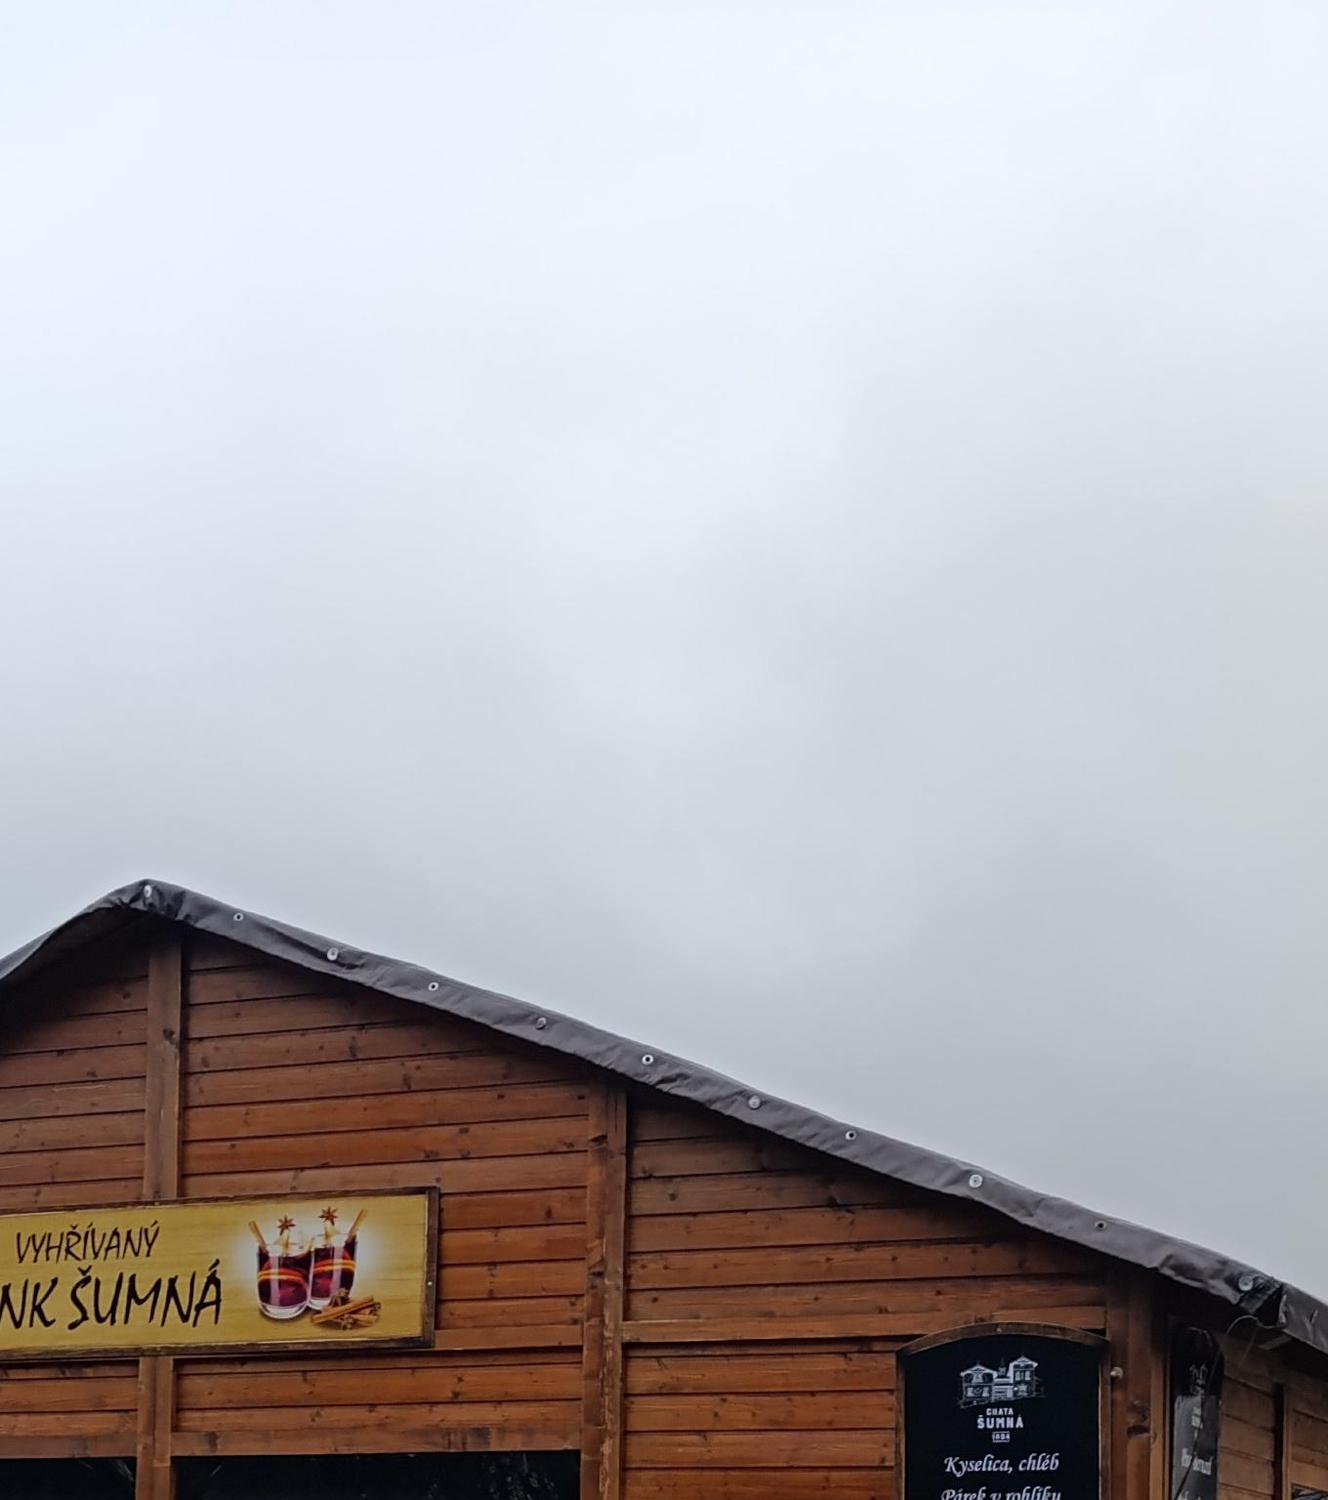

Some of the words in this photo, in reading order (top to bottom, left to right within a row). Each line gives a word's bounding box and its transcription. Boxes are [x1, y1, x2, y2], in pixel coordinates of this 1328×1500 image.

[15, 1220, 160, 1264] VYHŘÍVANÝ
[66, 1258, 224, 1330] ŠUMNÁ
[977, 1414, 1024, 1429] ŠUMNÁ
[943, 1453, 1013, 1478] Kyselica,
[1018, 1452, 1060, 1472] chléb
